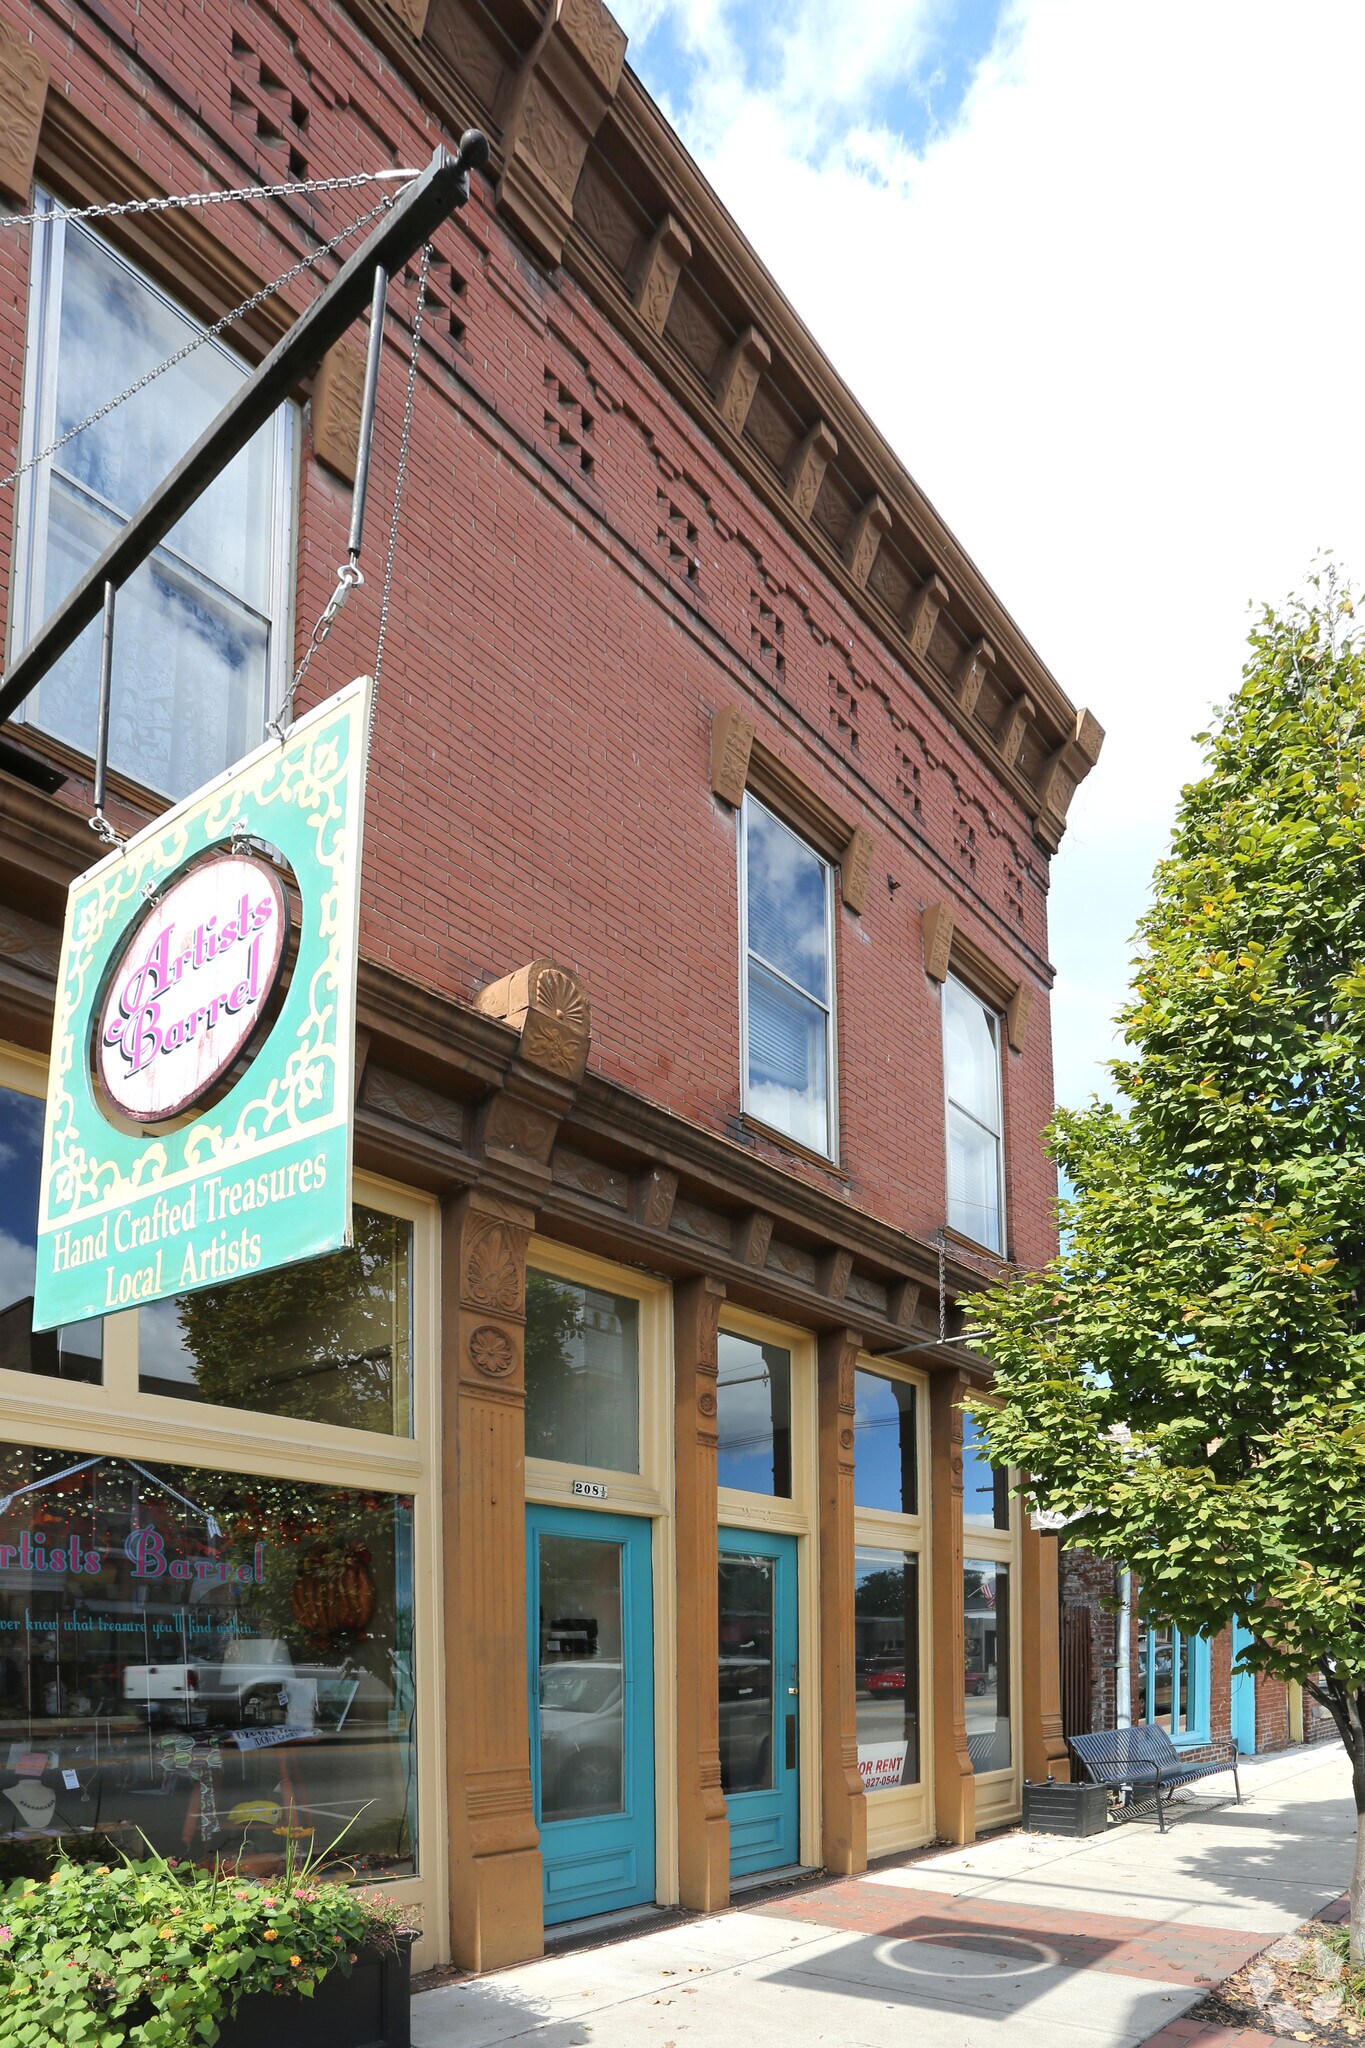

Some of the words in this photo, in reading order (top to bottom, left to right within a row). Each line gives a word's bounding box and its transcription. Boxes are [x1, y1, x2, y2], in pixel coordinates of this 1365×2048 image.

[121, 893, 273, 1016] Artists
[104, 931, 265, 1078] Barrel
[52, 1215, 109, 1274] Hand
[113, 1183, 197, 1253] Crafted
[203, 1152, 328, 1224] Treasures
[104, 1248, 163, 1307] Local
[178, 1227, 262, 1287] Artists
[0, 1530, 102, 1575] rtists
[124, 1523, 268, 1584] Barrel
[25, 1607, 59, 1631] know
[63, 1609, 94, 1632] what
[97, 1616, 147, 1633] treasure
[152, 1612, 185, 1640] you'll
[188, 1613, 212, 1641] find
[858, 1760, 873, 1776] OR
[875, 1757, 903, 1774] RENT
